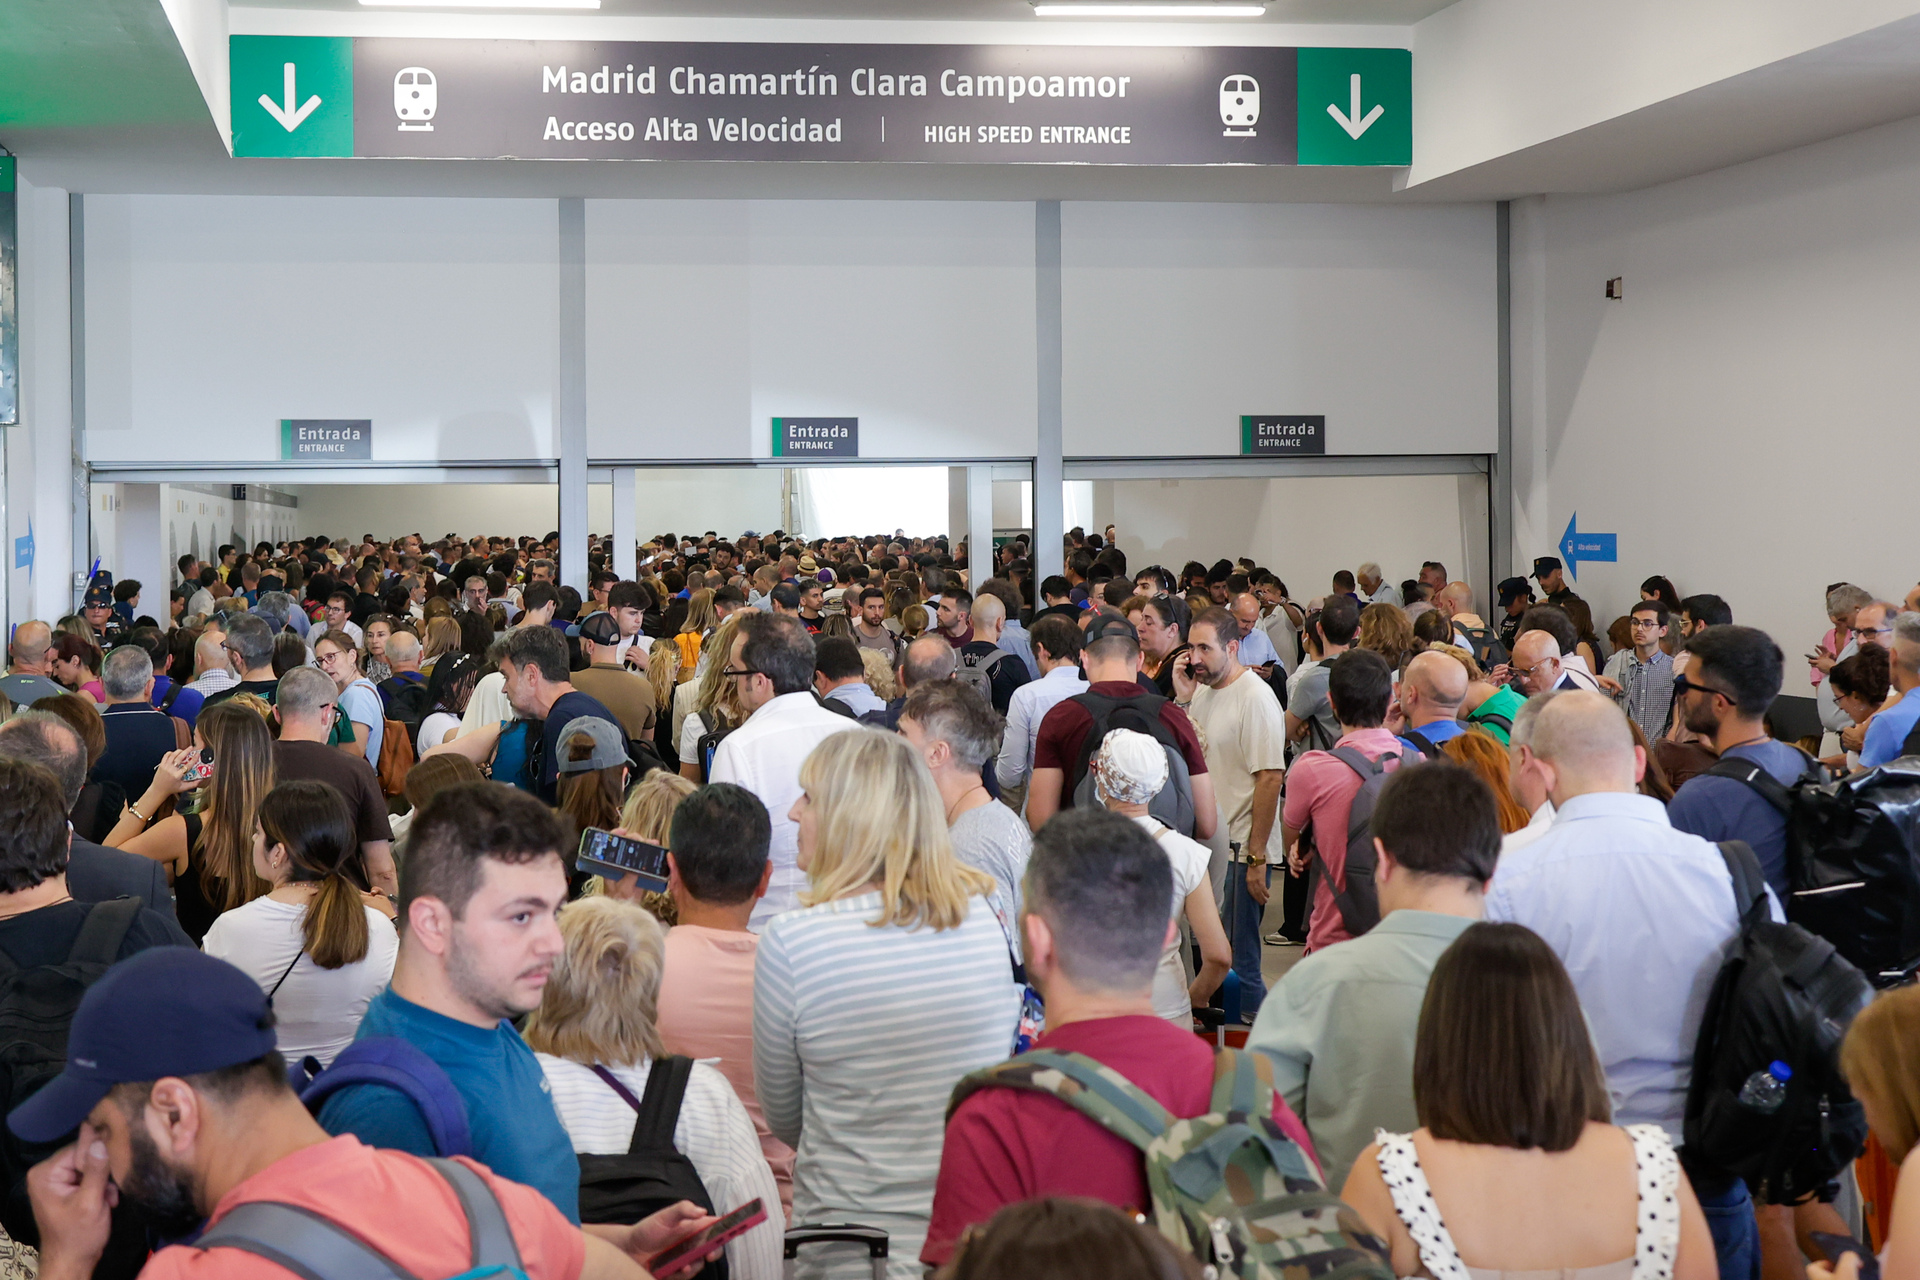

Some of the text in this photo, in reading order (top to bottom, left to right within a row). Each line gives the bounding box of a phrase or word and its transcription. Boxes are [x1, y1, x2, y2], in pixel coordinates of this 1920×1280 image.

[542, 64, 1131, 103] Madrid Chamartín Clara Campoamor
[542, 116, 842, 143] Acceso Alta Velocidad
[924, 125, 1131, 144] HIGH SPEED ENTRANCE
[299, 427, 361, 440] Entrada
[789, 425, 848, 438] Entrada
[1258, 423, 1315, 435] Entrada
[299, 444, 345, 452] ENTRANCE
[789, 441, 834, 449] ENTRANCE
[1258, 438, 1301, 447] ENTRANCE
